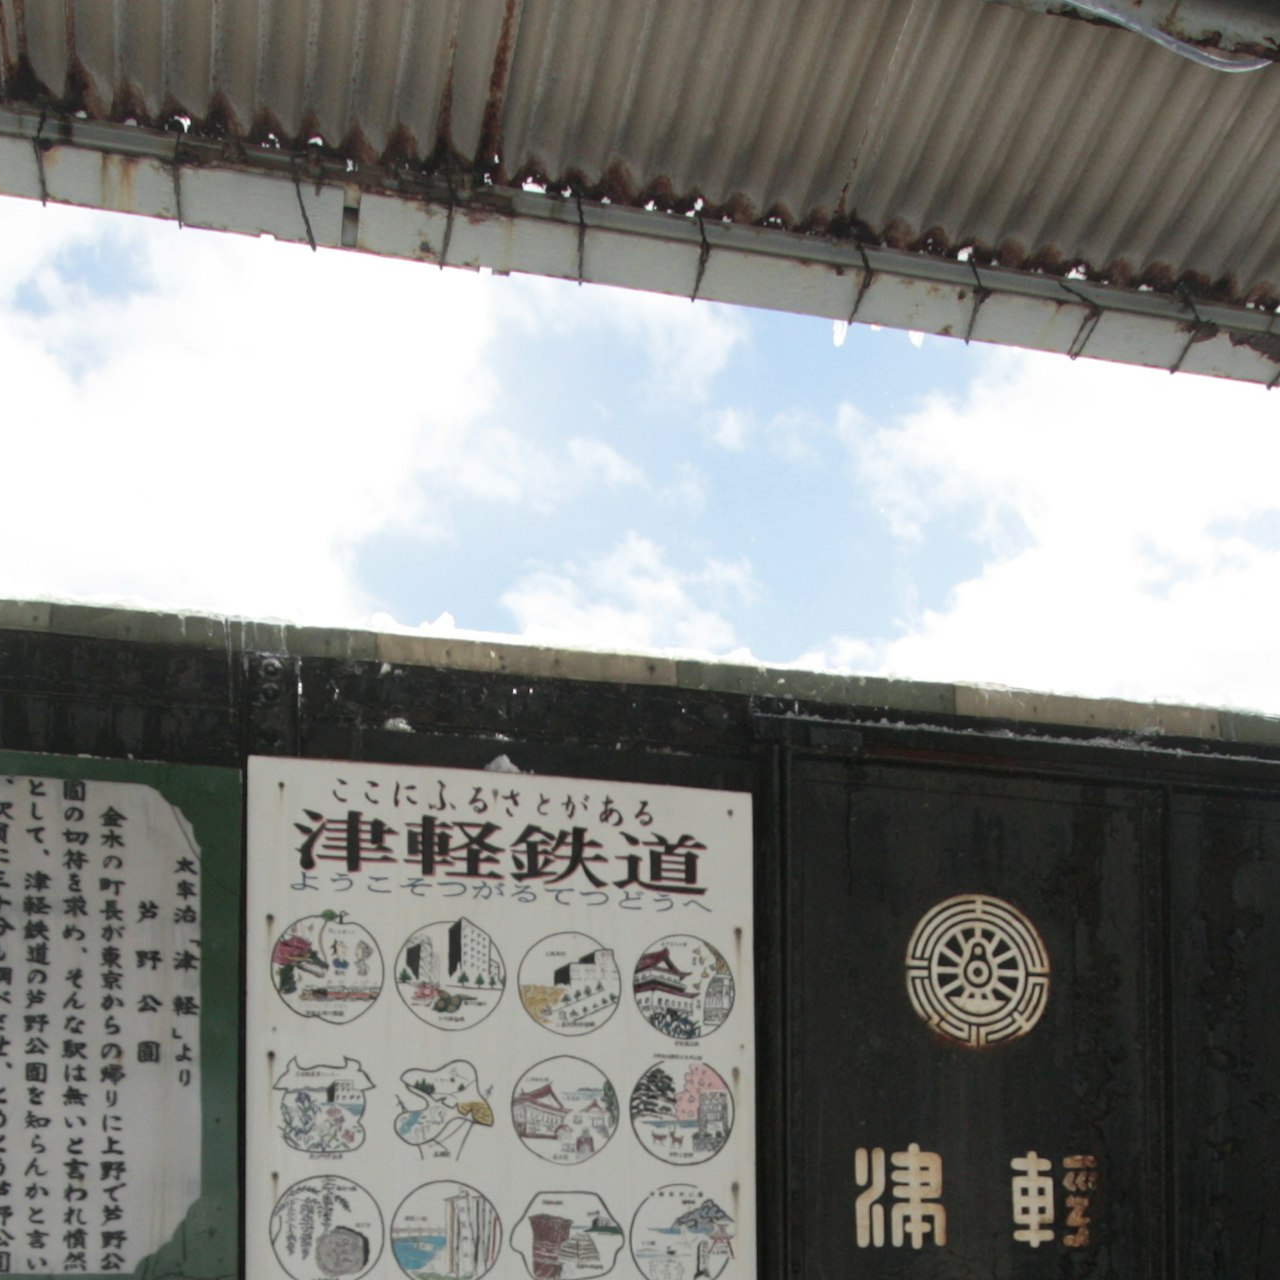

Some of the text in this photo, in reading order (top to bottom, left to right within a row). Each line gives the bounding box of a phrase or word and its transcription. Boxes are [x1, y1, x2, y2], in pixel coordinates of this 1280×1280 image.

[331, 777, 655, 827] ここにふるさとがある
[293, 808, 709, 897] 津軽鉄道
[289, 870, 713, 914] ようこそつがるてつどうへ
